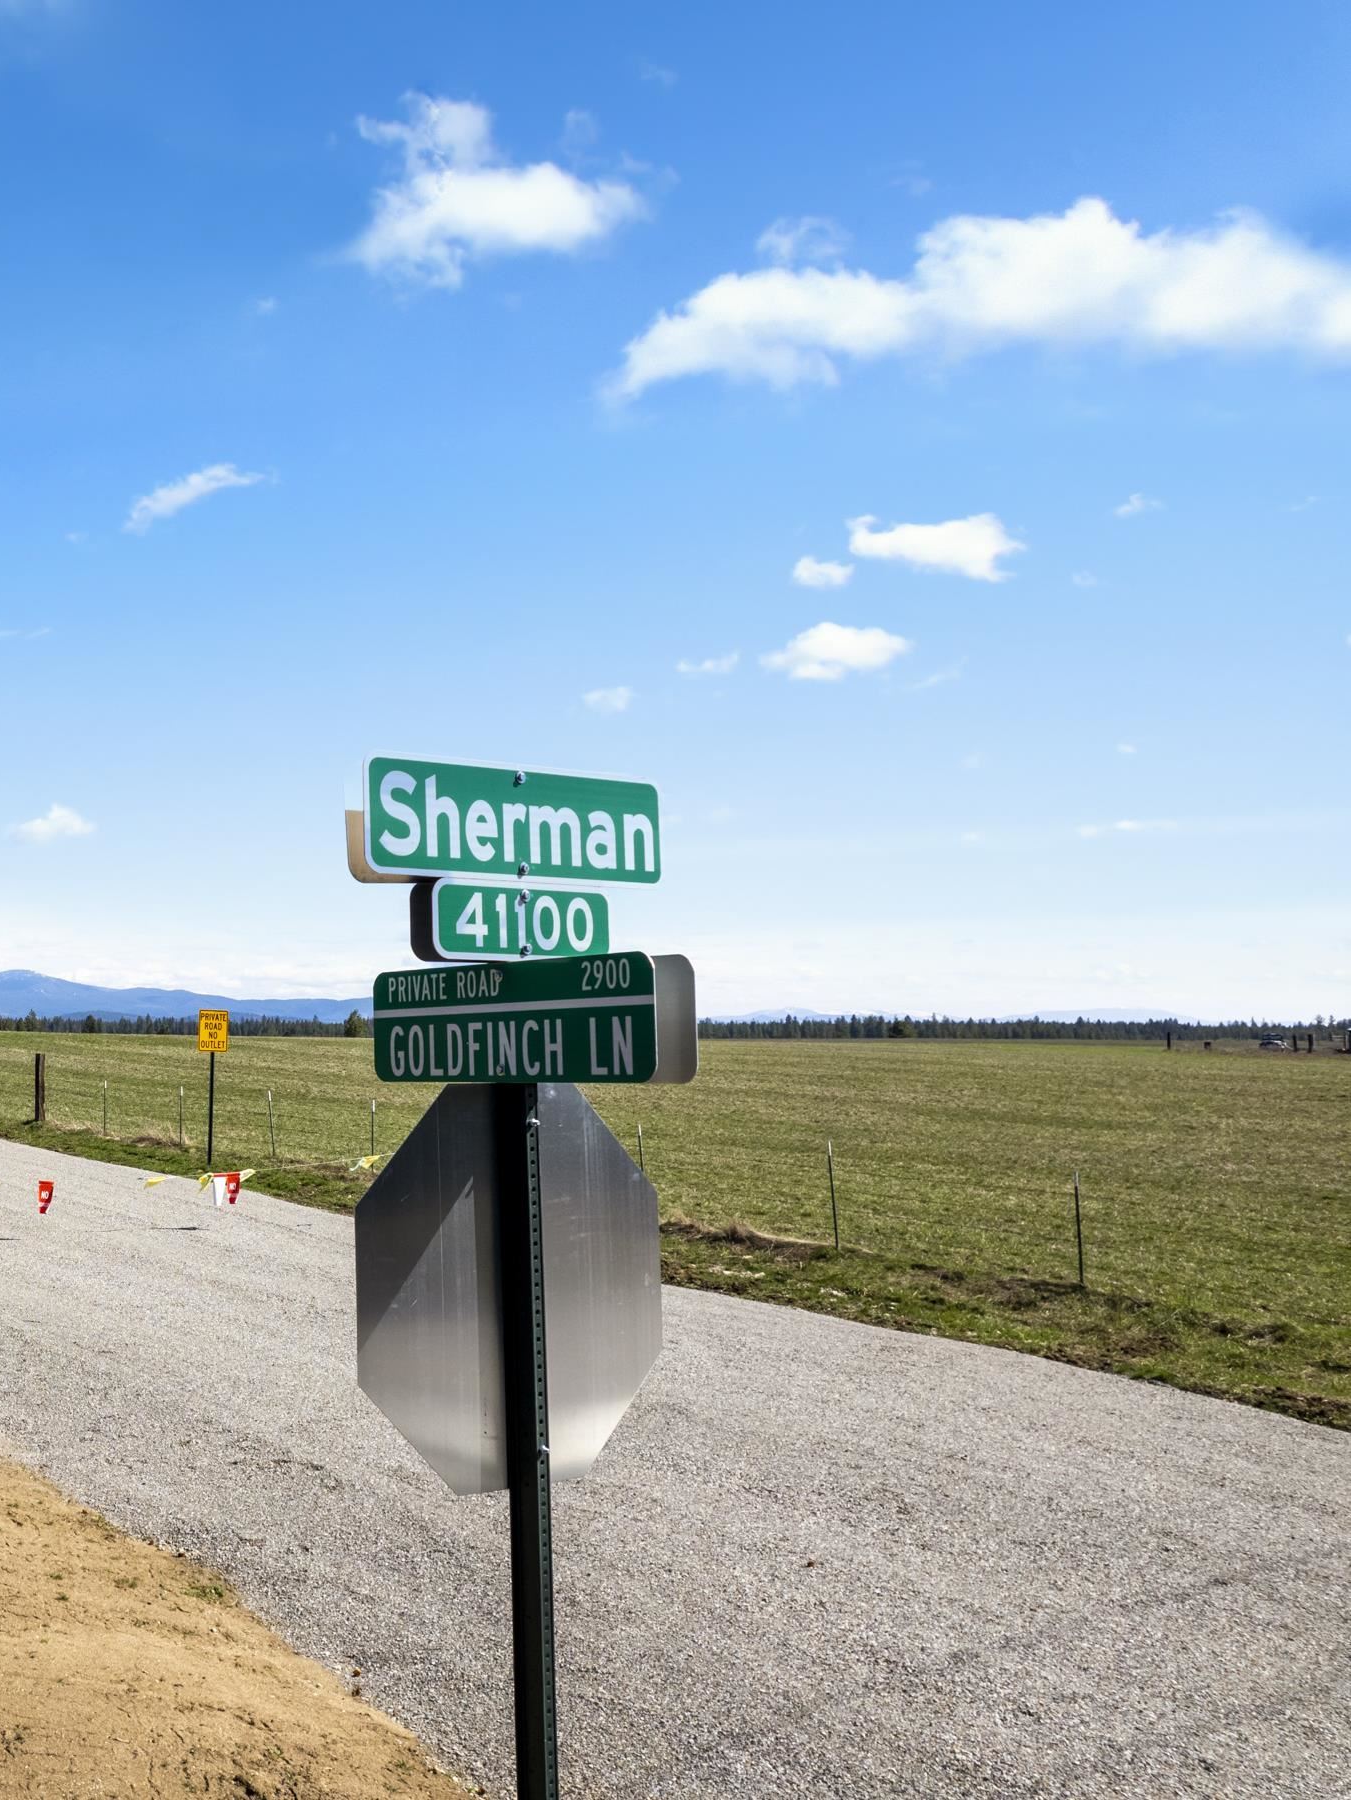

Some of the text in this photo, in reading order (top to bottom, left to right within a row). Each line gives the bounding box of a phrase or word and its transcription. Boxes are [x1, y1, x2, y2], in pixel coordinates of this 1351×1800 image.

[379, 770, 655, 872] Sherman
[456, 892, 594, 952] 41100
[581, 958, 631, 991] 2900
[388, 969, 501, 1003] PRIVATE ROAD
[200, 1013, 227, 1021] PRIVATE
[205, 1022, 223, 1030] ROAD
[201, 1040, 226, 1049] OUTLET
[209, 1031, 218, 1039] NO
[390, 1016, 634, 1077] GOLDFINCH LN
[41, 1191, 49, 1199] NO
